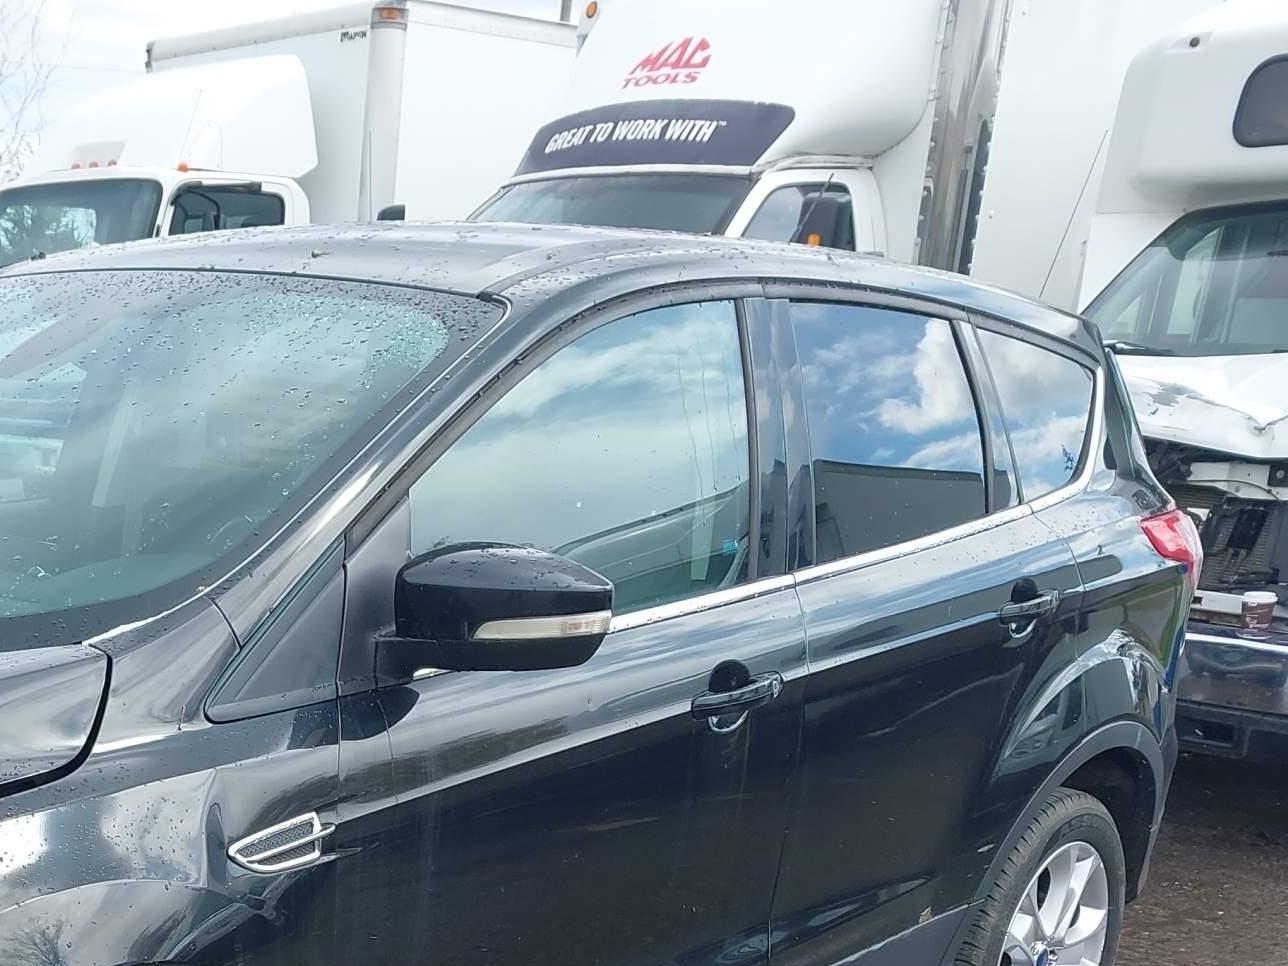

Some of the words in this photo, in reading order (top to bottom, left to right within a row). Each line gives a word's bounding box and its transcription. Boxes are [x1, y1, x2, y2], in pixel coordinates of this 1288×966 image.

[629, 36, 711, 75] MAC
[622, 71, 701, 89] TOOLS
[544, 124, 594, 154] GREAT
[589, 121, 614, 143] TO
[611, 118, 669, 141] WORK
